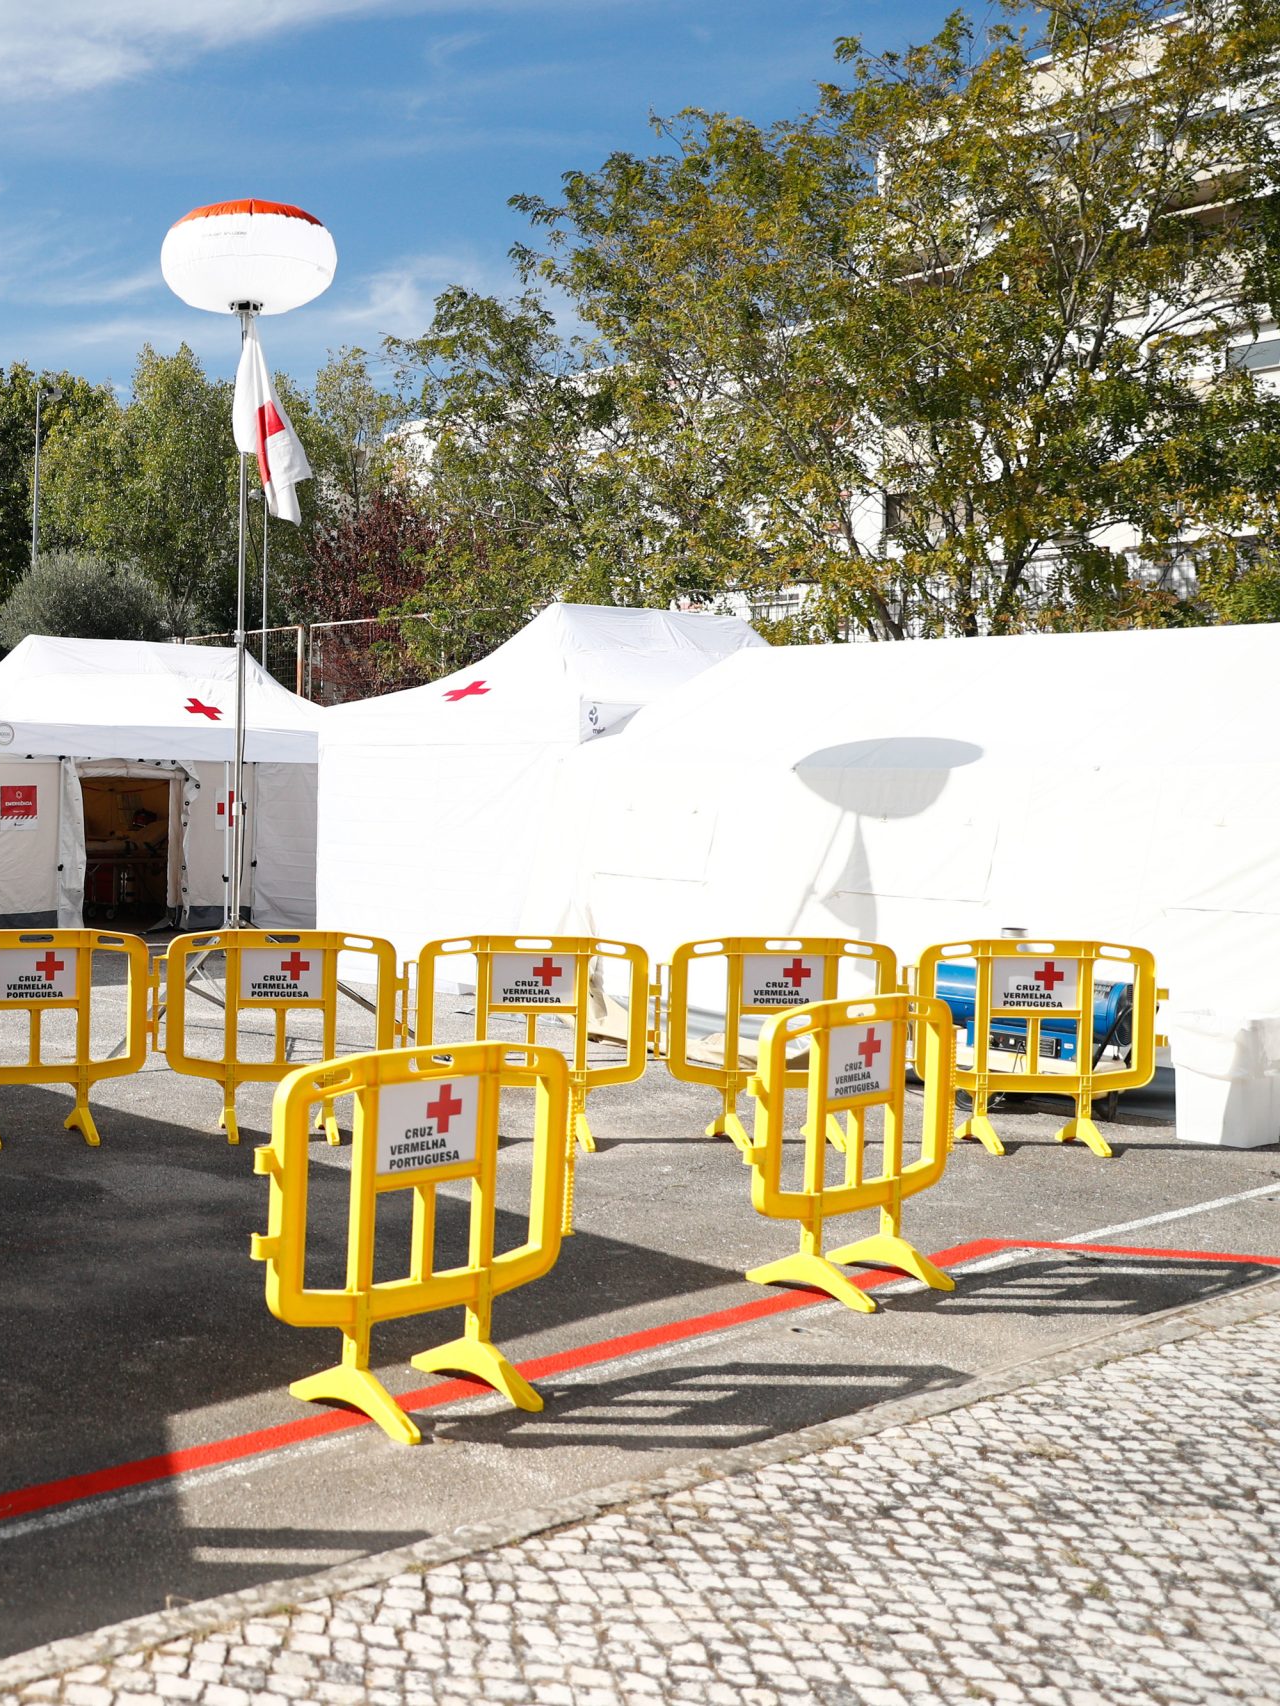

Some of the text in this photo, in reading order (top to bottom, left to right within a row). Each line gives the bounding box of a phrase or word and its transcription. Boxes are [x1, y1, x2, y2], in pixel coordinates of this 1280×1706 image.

[1003, 1000, 1063, 1008] PORTUGUESA
[844, 1061, 862, 1072] CRUZ
[835, 1071, 871, 1085] VERMELHA
[834, 1081, 879, 1096] PORTUGUESA
[405, 1126, 433, 1139] CRUZ
[390, 1138, 446, 1156] VERMELHA
[389, 1150, 459, 1170] PORTUGUESA
